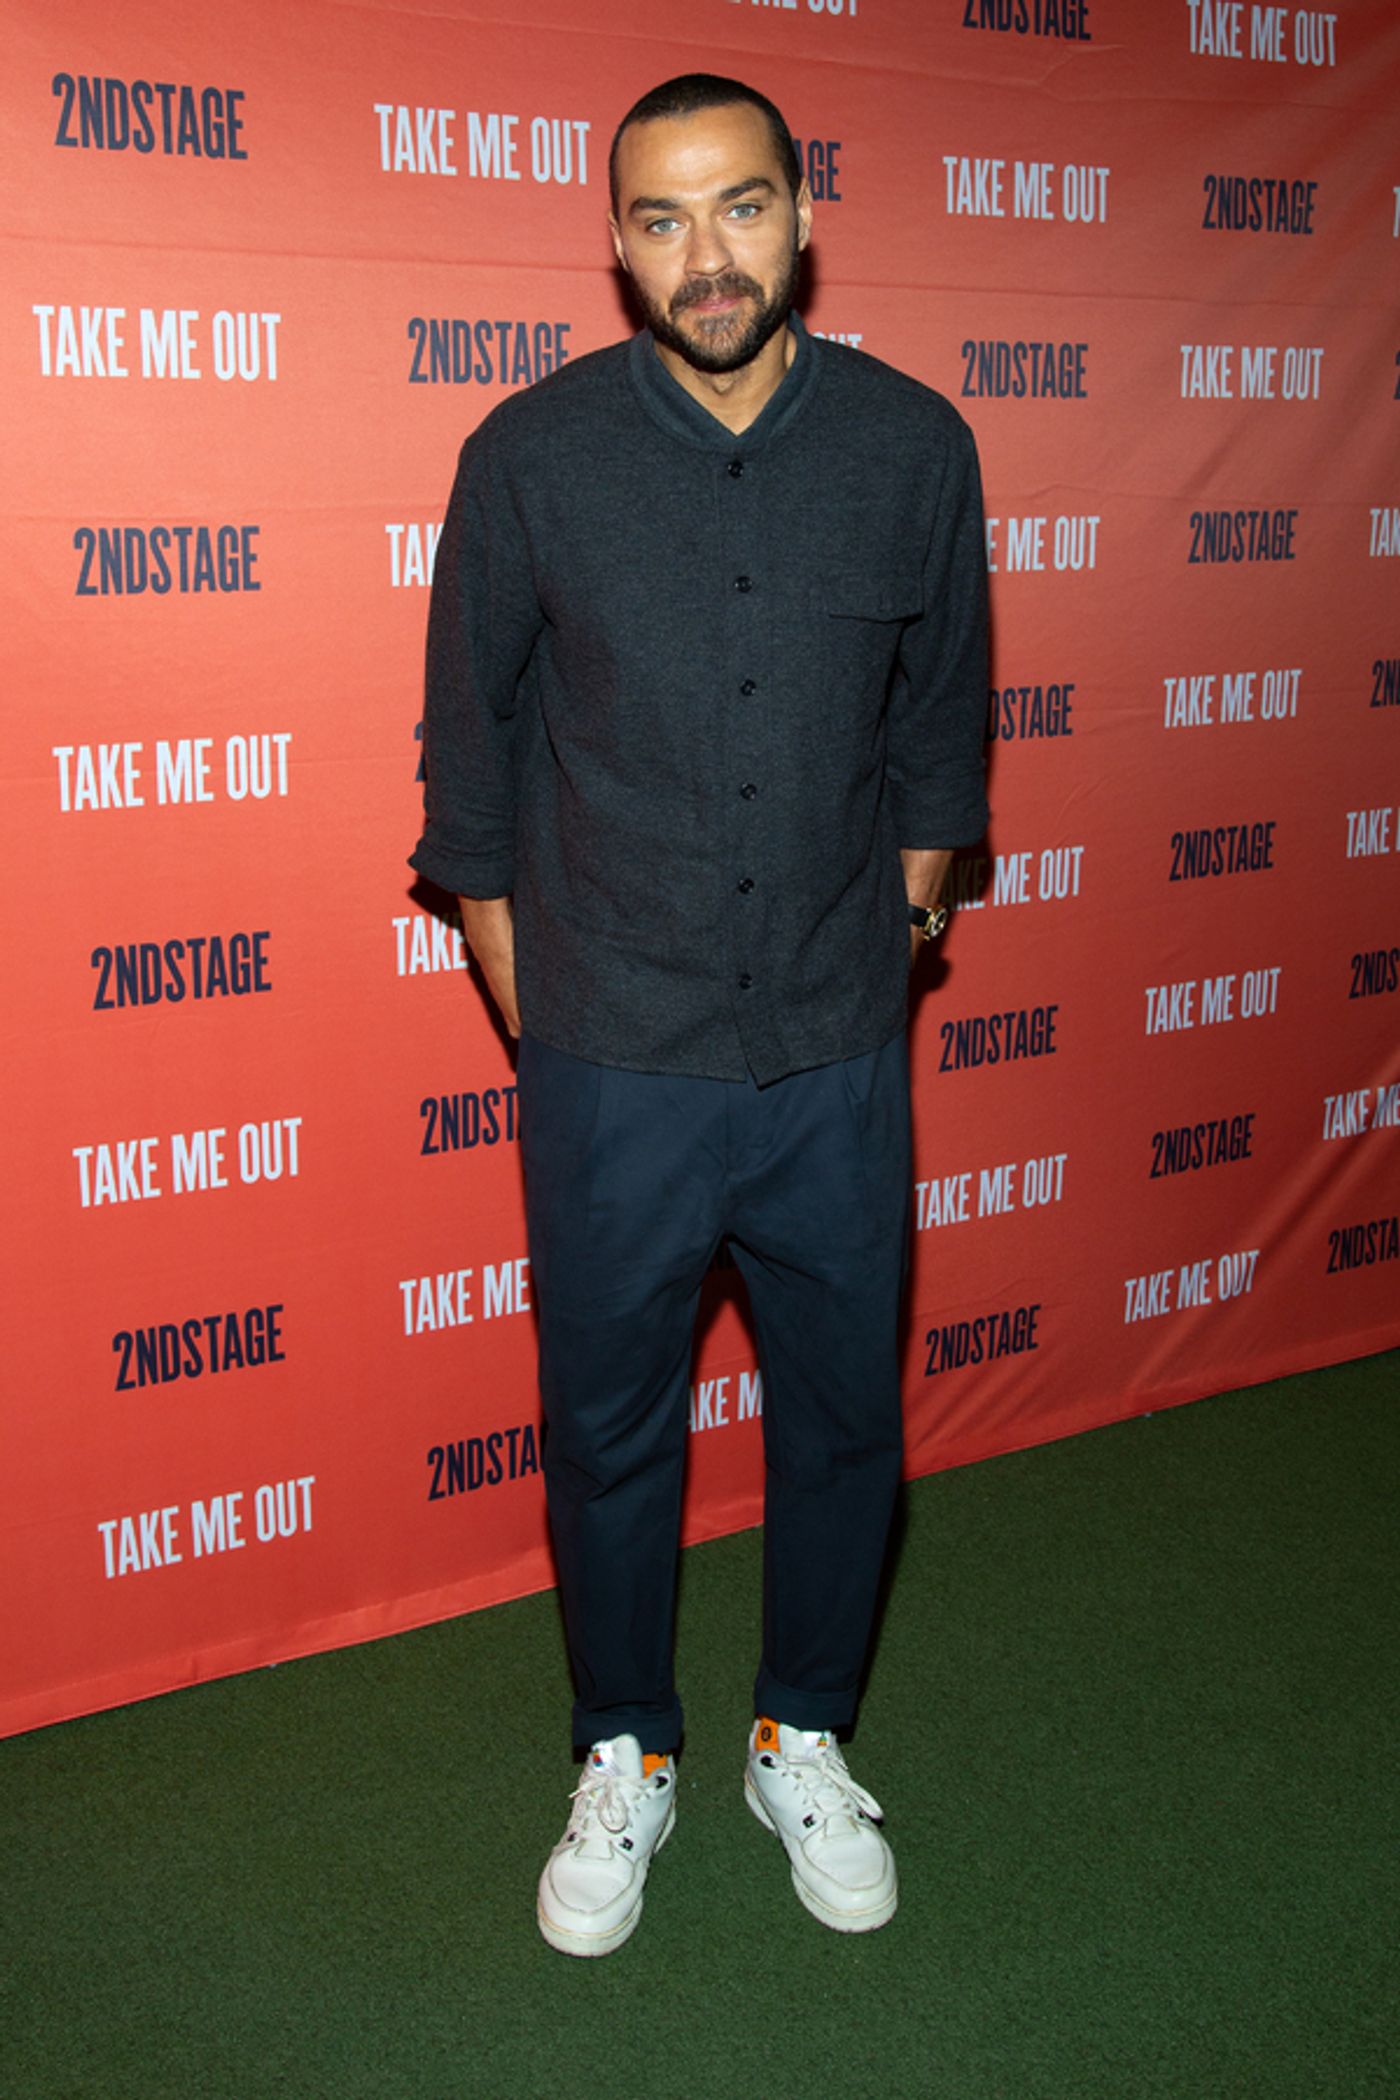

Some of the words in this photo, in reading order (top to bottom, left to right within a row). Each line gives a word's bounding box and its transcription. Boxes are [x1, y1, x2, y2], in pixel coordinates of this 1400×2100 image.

[1187, 0, 1243, 57] TAKE
[1251, 5, 1287, 61] ME
[1295, 10, 1336, 66] OUT
[53, 73, 247, 159] 2NDSTAGE
[374, 104, 457, 175] TAKE
[468, 112, 520, 179] ME
[531, 117, 590, 184] OUT
[943, 157, 1004, 216] TAKE
[1014, 162, 1054, 219] ME
[1064, 165, 1109, 222] OUT
[1203, 175, 1318, 234] 2NDSTAGE
[33, 305, 128, 376] TAKE
[140, 309, 200, 378] ME
[213, 311, 280, 380] OUT
[408, 317, 571, 385] 2NDSTAGE
[962, 341, 1088, 398] 2NDSTAGE
[1181, 346, 1233, 398] TAKE
[1241, 347, 1277, 398] ME
[1282, 347, 1323, 400] OUT
[74, 526, 260, 595] 2NDSTAGE
[1007, 518, 1046, 571] ME
[1055, 516, 1100, 570] OUT
[1189, 510, 1298, 563] 2NDSTAGE
[1164, 676, 1215, 727] TAKE
[1221, 673, 1256, 722] ME
[1261, 669, 1302, 719] OUT
[53, 743, 144, 811] TAKE
[157, 739, 213, 804] ME
[227, 734, 291, 800] OUT
[1170, 822, 1276, 881] 2NDSTAGE
[1347, 808, 1392, 857] TAKE
[994, 853, 1032, 906] ME
[1039, 847, 1084, 900] OUT
[92, 931, 271, 1010] 2NDSTAGE
[392, 913, 468, 976] TAKE
[1146, 982, 1196, 1034] TAKE
[1202, 975, 1235, 1024] ME
[1241, 968, 1280, 1018] OUT
[940, 1005, 1058, 1072] 2NDSTAGE
[420, 1087, 521, 1155] 2NDST
[1151, 1114, 1255, 1178] 2NDSTAGE
[1324, 1089, 1370, 1139] TAKE
[73, 1138, 160, 1207] TAKE
[172, 1128, 227, 1193] ME
[239, 1118, 301, 1183] OUT
[916, 1173, 972, 1229] TAKE
[979, 1164, 1016, 1217] ME
[1023, 1154, 1067, 1207] OUT
[400, 1269, 472, 1335] TAKE
[484, 1259, 529, 1319] ME
[1125, 1270, 1173, 1323] TAKE
[1178, 1260, 1211, 1309] ME
[1219, 1250, 1259, 1300] OUT
[113, 1305, 285, 1391] 2NDSTAGE
[925, 1305, 1040, 1376] 2NDSTAGE
[427, 1424, 545, 1500] 2NDSTA
[98, 1506, 181, 1578] TAKE
[192, 1492, 245, 1557] ME
[255, 1476, 314, 1541] OUT
